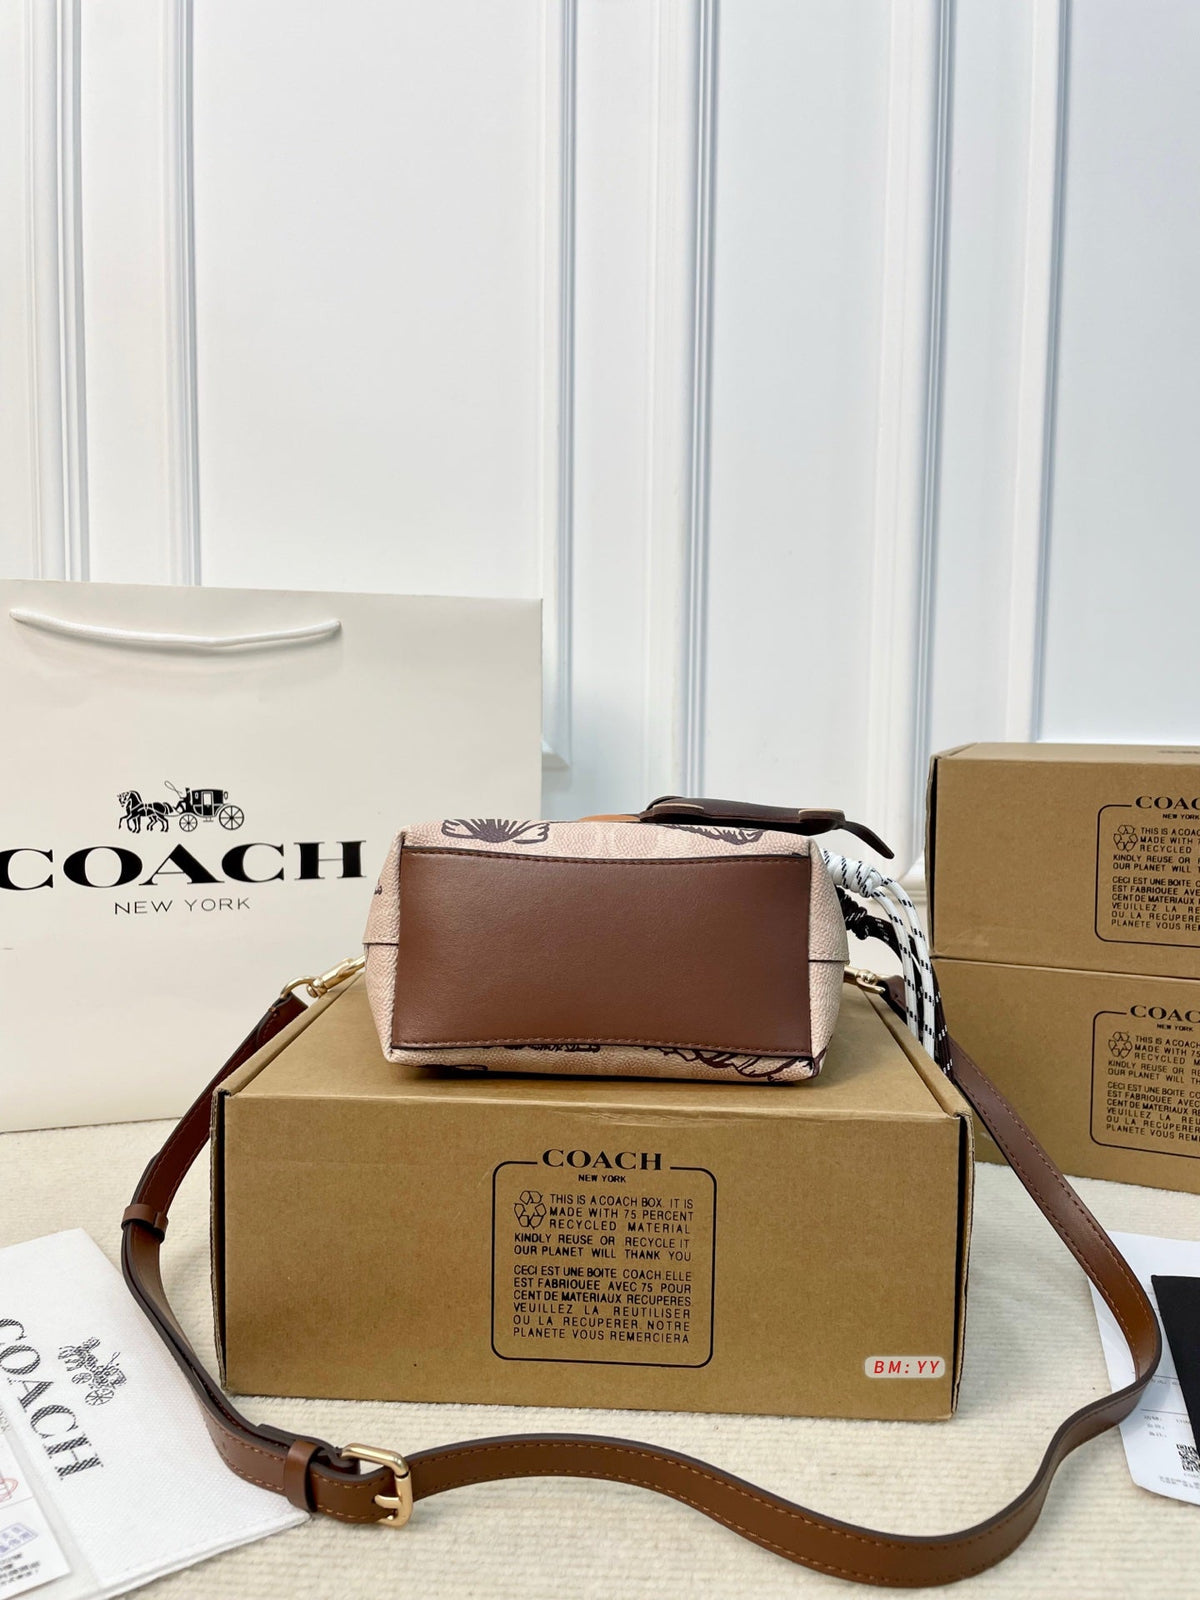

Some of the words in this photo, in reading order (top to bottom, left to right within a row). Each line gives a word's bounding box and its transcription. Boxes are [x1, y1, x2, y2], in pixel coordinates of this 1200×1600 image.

[0, 840, 367, 891] COACH
[114, 900, 173, 915] NEW
[184, 897, 251, 912] YORK
[542, 1148, 661, 1170] COACH
[578, 1174, 598, 1182] NEW
[602, 1174, 626, 1183] YORK
[550, 1194, 573, 1204] THIS
[576, 1194, 586, 1205] IS
[590, 1195, 597, 1205] A
[599, 1195, 637, 1207] COACH
[670, 1198, 680, 1209] IT
[684, 1199, 693, 1209] IS
[549, 1206, 582, 1217] MADE
[588, 1208, 618, 1218] WITH
[624, 1209, 637, 1220] 75
[642, 1210, 694, 1221] PERCENT
[549, 1219, 616, 1231] RECYCLED
[627, 1222, 690, 1234] MATERIAL
[514, 1232, 552, 1243] KINDLY
[558, 1234, 593, 1244] REUSE
[600, 1235, 615, 1246] OR
[625, 1237, 675, 1248] RECYCLE
[680, 1239, 690, 1248] IT
[514, 1245, 537, 1255] OUR
[542, 1245, 584, 1257] PLANET
[591, 1248, 616, 1258] WILL
[625, 1249, 660, 1260] THANK
[514, 1265, 537, 1276] CECI
[541, 1265, 560, 1276] EST
[563, 1267, 584, 1277] UNE
[587, 1267, 617, 1278] BOITE
[514, 1277, 534, 1288] EST
[608, 1281, 637, 1292] AVEC
[641, 1282, 653, 1292] 75
[660, 1283, 691, 1294] POUR
[513, 1290, 542, 1300] CENT
[544, 1291, 558, 1301] DE
[561, 1291, 621, 1304] MATERIAUX
[513, 1302, 572, 1314] VEUILLEZ
[585, 1305, 599, 1315] LA
[613, 1306, 690, 1319] REUTILISER
[513, 1314, 530, 1325] OU
[539, 1316, 553, 1326] LA
[647, 1320, 690, 1332] NOTRE
[513, 1327, 566, 1338] PLANETE
[572, 1329, 604, 1340] VOUS
[610, 1331, 689, 1343] REMERCIERA
